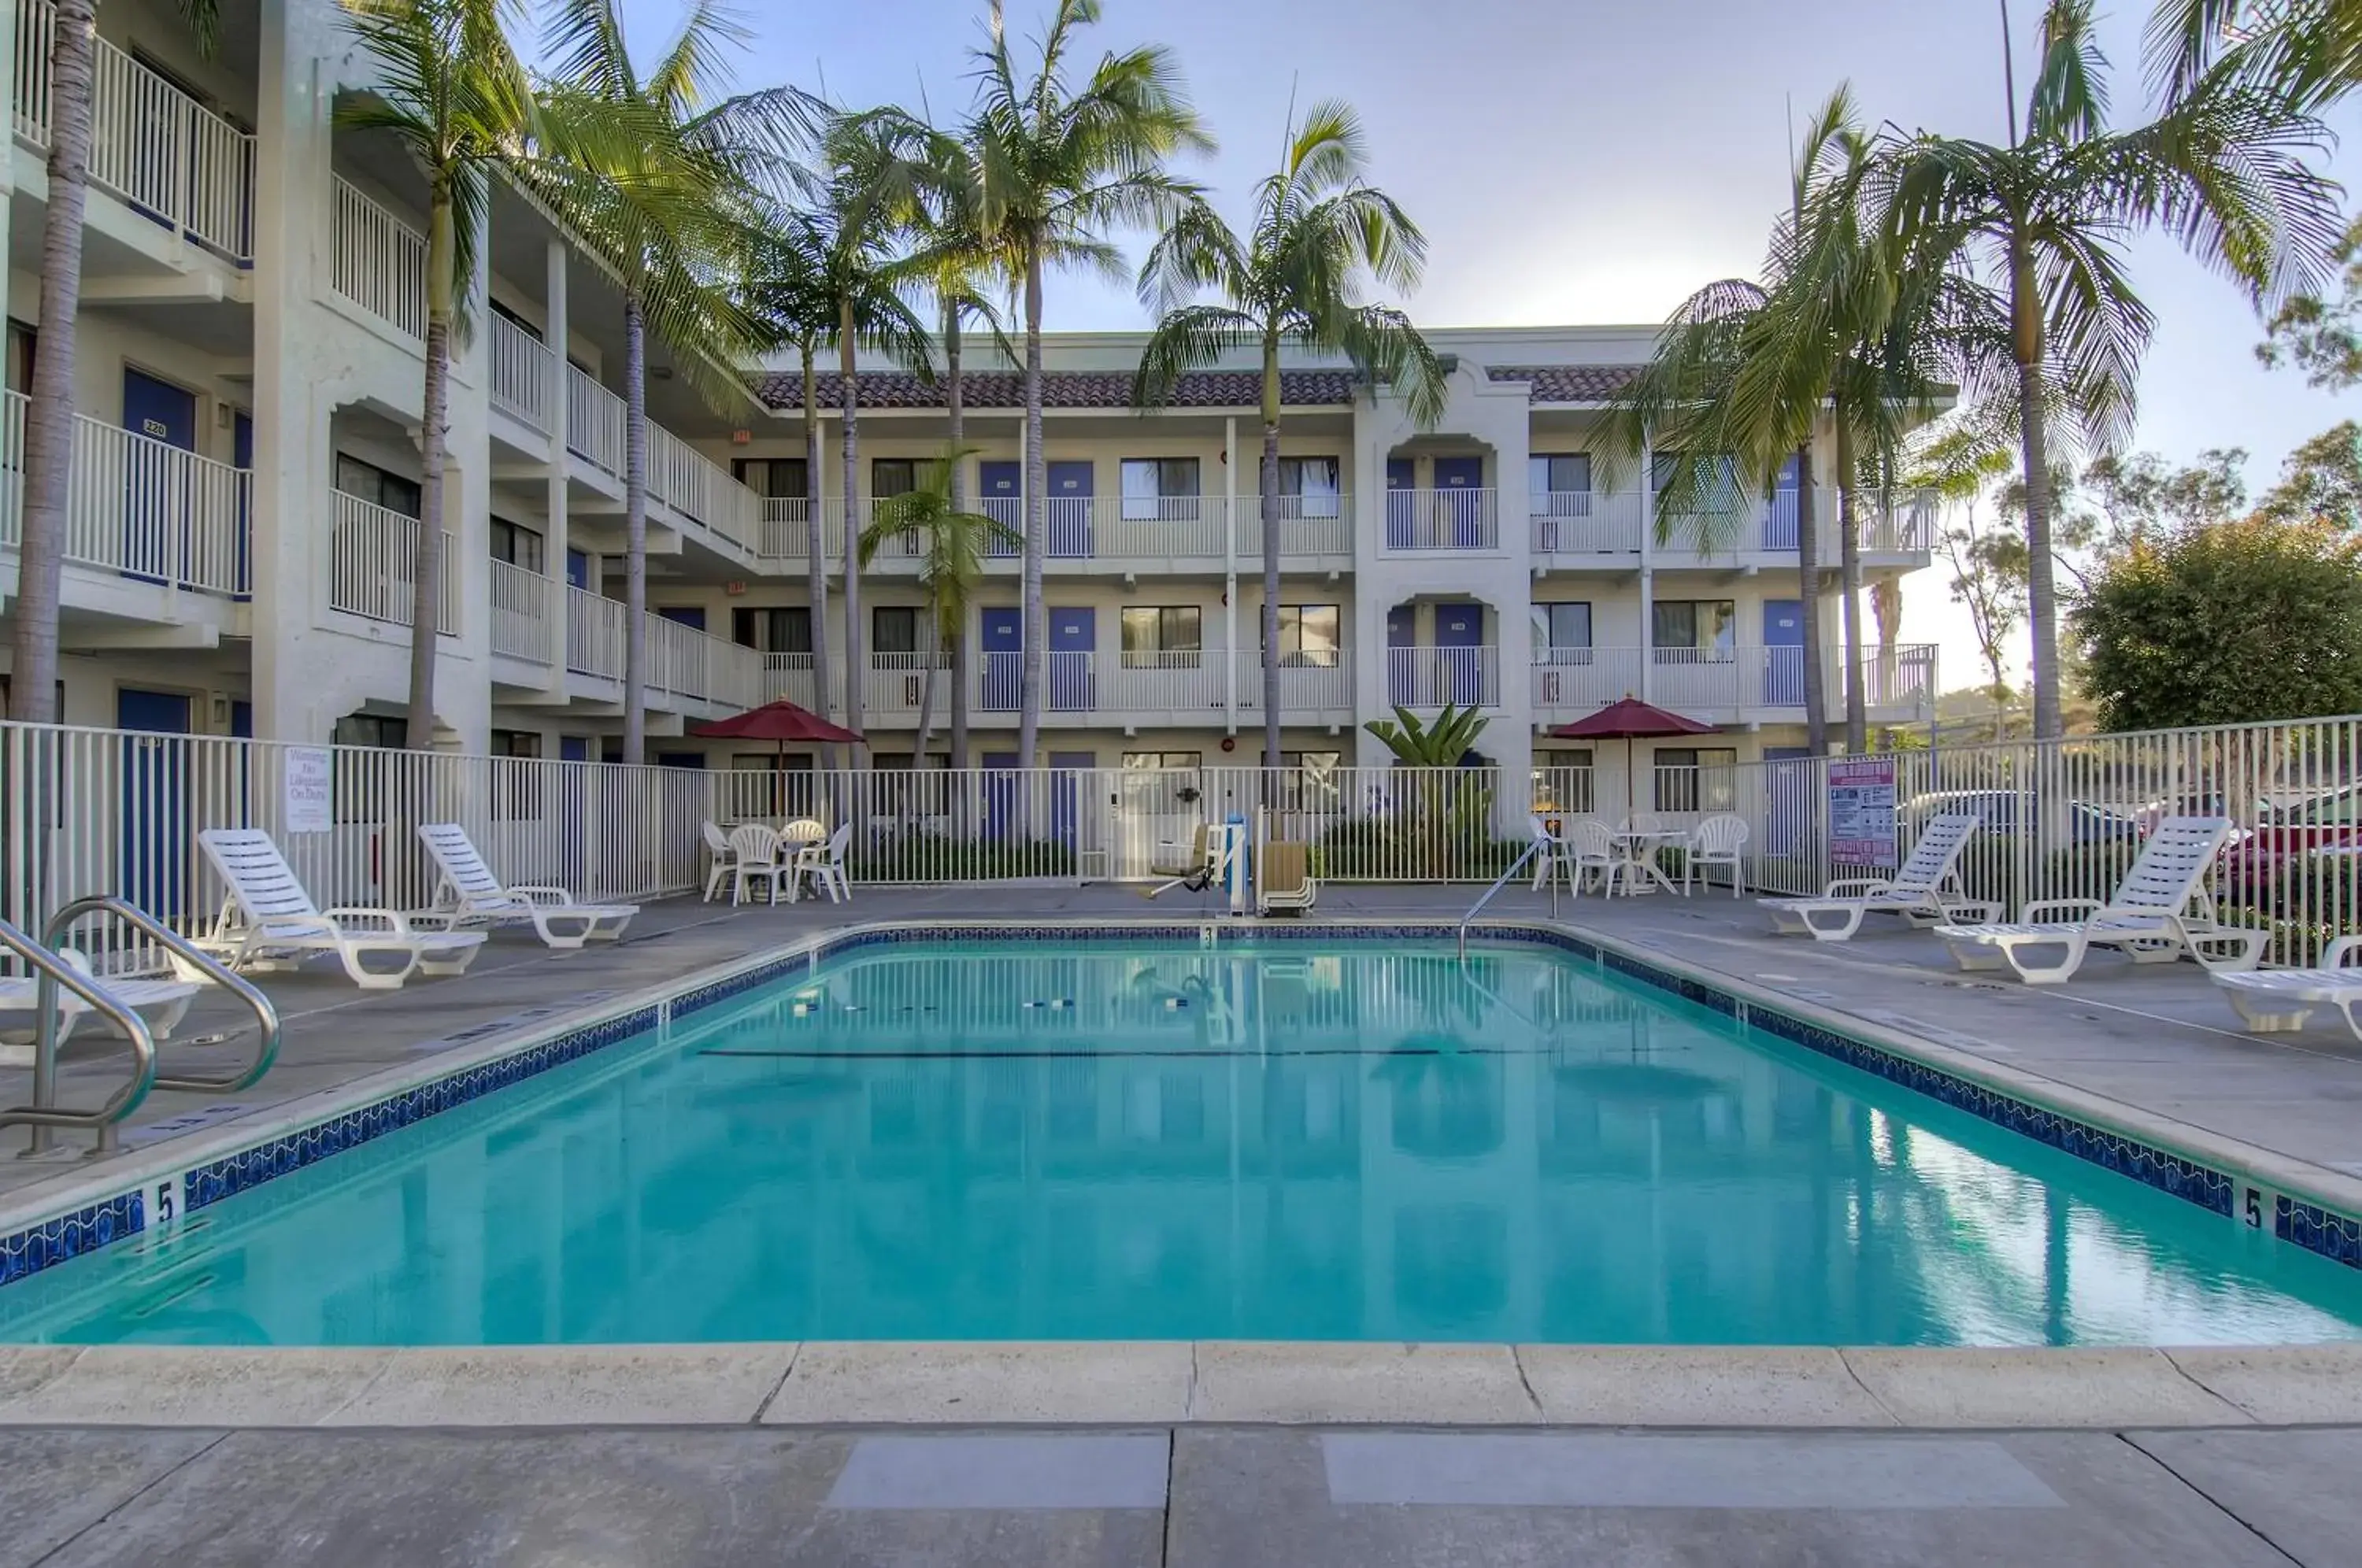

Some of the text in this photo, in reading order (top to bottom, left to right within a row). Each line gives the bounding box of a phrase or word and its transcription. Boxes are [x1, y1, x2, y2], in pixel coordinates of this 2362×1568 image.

[146, 421, 165, 436] 220
[1205, 926, 1212, 951] 3
[158, 1181, 173, 1222] 5
[2245, 1187, 2261, 1229] 5
